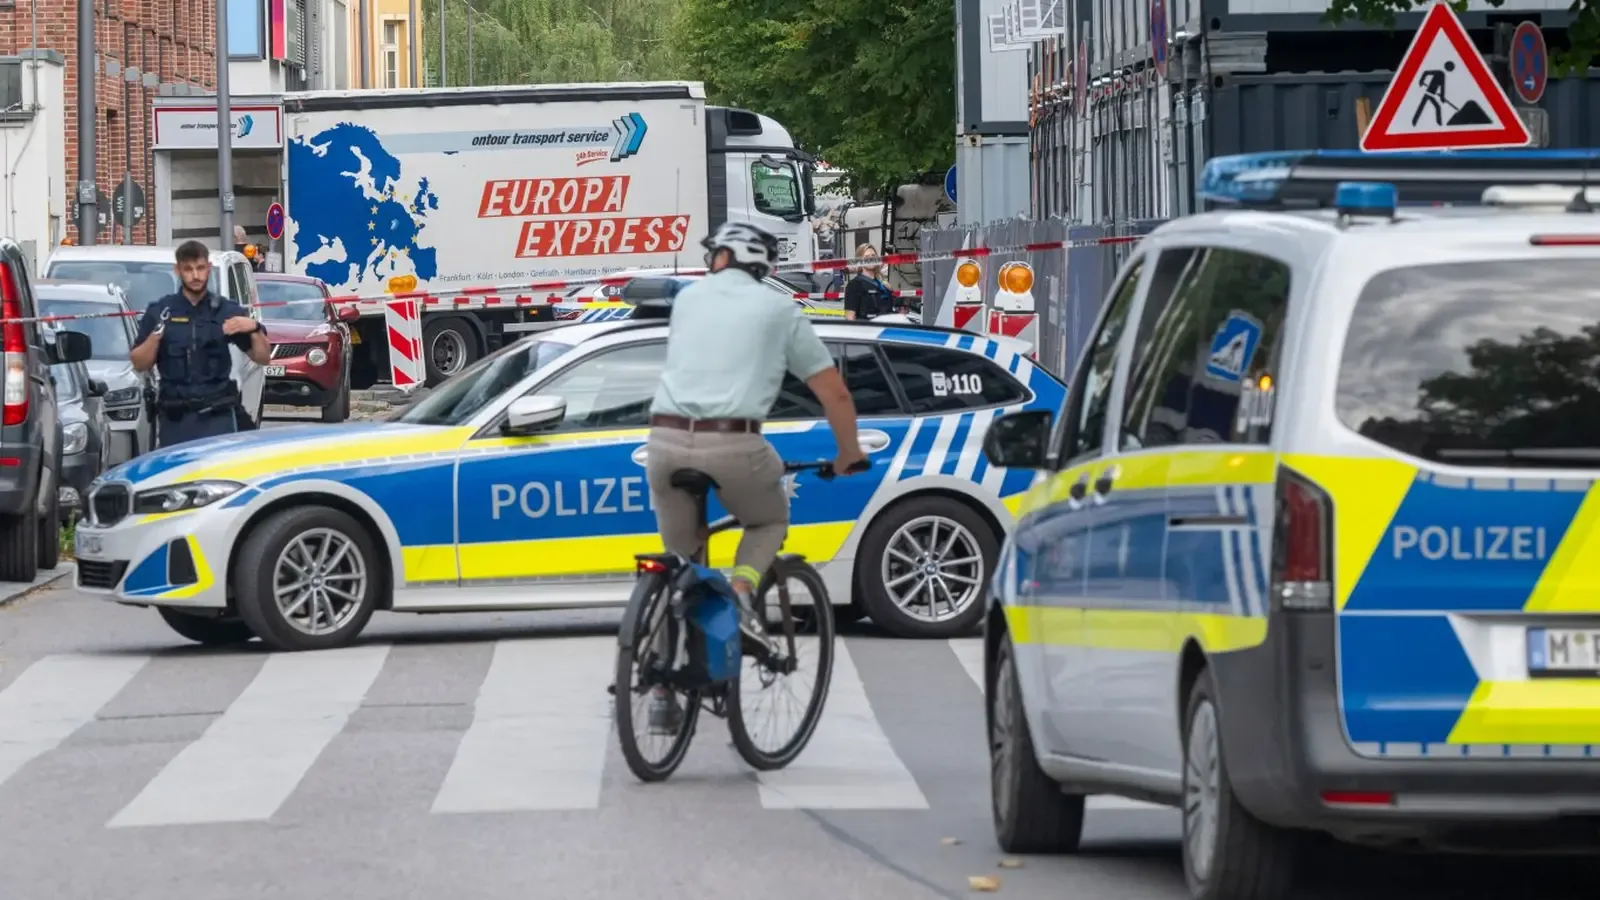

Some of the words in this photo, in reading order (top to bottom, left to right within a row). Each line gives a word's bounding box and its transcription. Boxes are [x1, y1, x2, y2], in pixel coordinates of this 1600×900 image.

[471, 133, 510, 146] ontour
[512, 131, 565, 145] transport
[567, 130, 609, 143] service
[587, 150, 608, 158] Service
[484, 177, 624, 217] EUROPA
[521, 216, 687, 257] EXPRESS
[439, 273, 472, 282] Frankfurt
[477, 271, 493, 280] Köln
[498, 270, 525, 280] London
[530, 268, 560, 278] Grefrath
[564, 267, 597, 278] Hamburg
[951, 373, 983, 395] 110
[1392, 525, 1547, 560] POLIZEI
